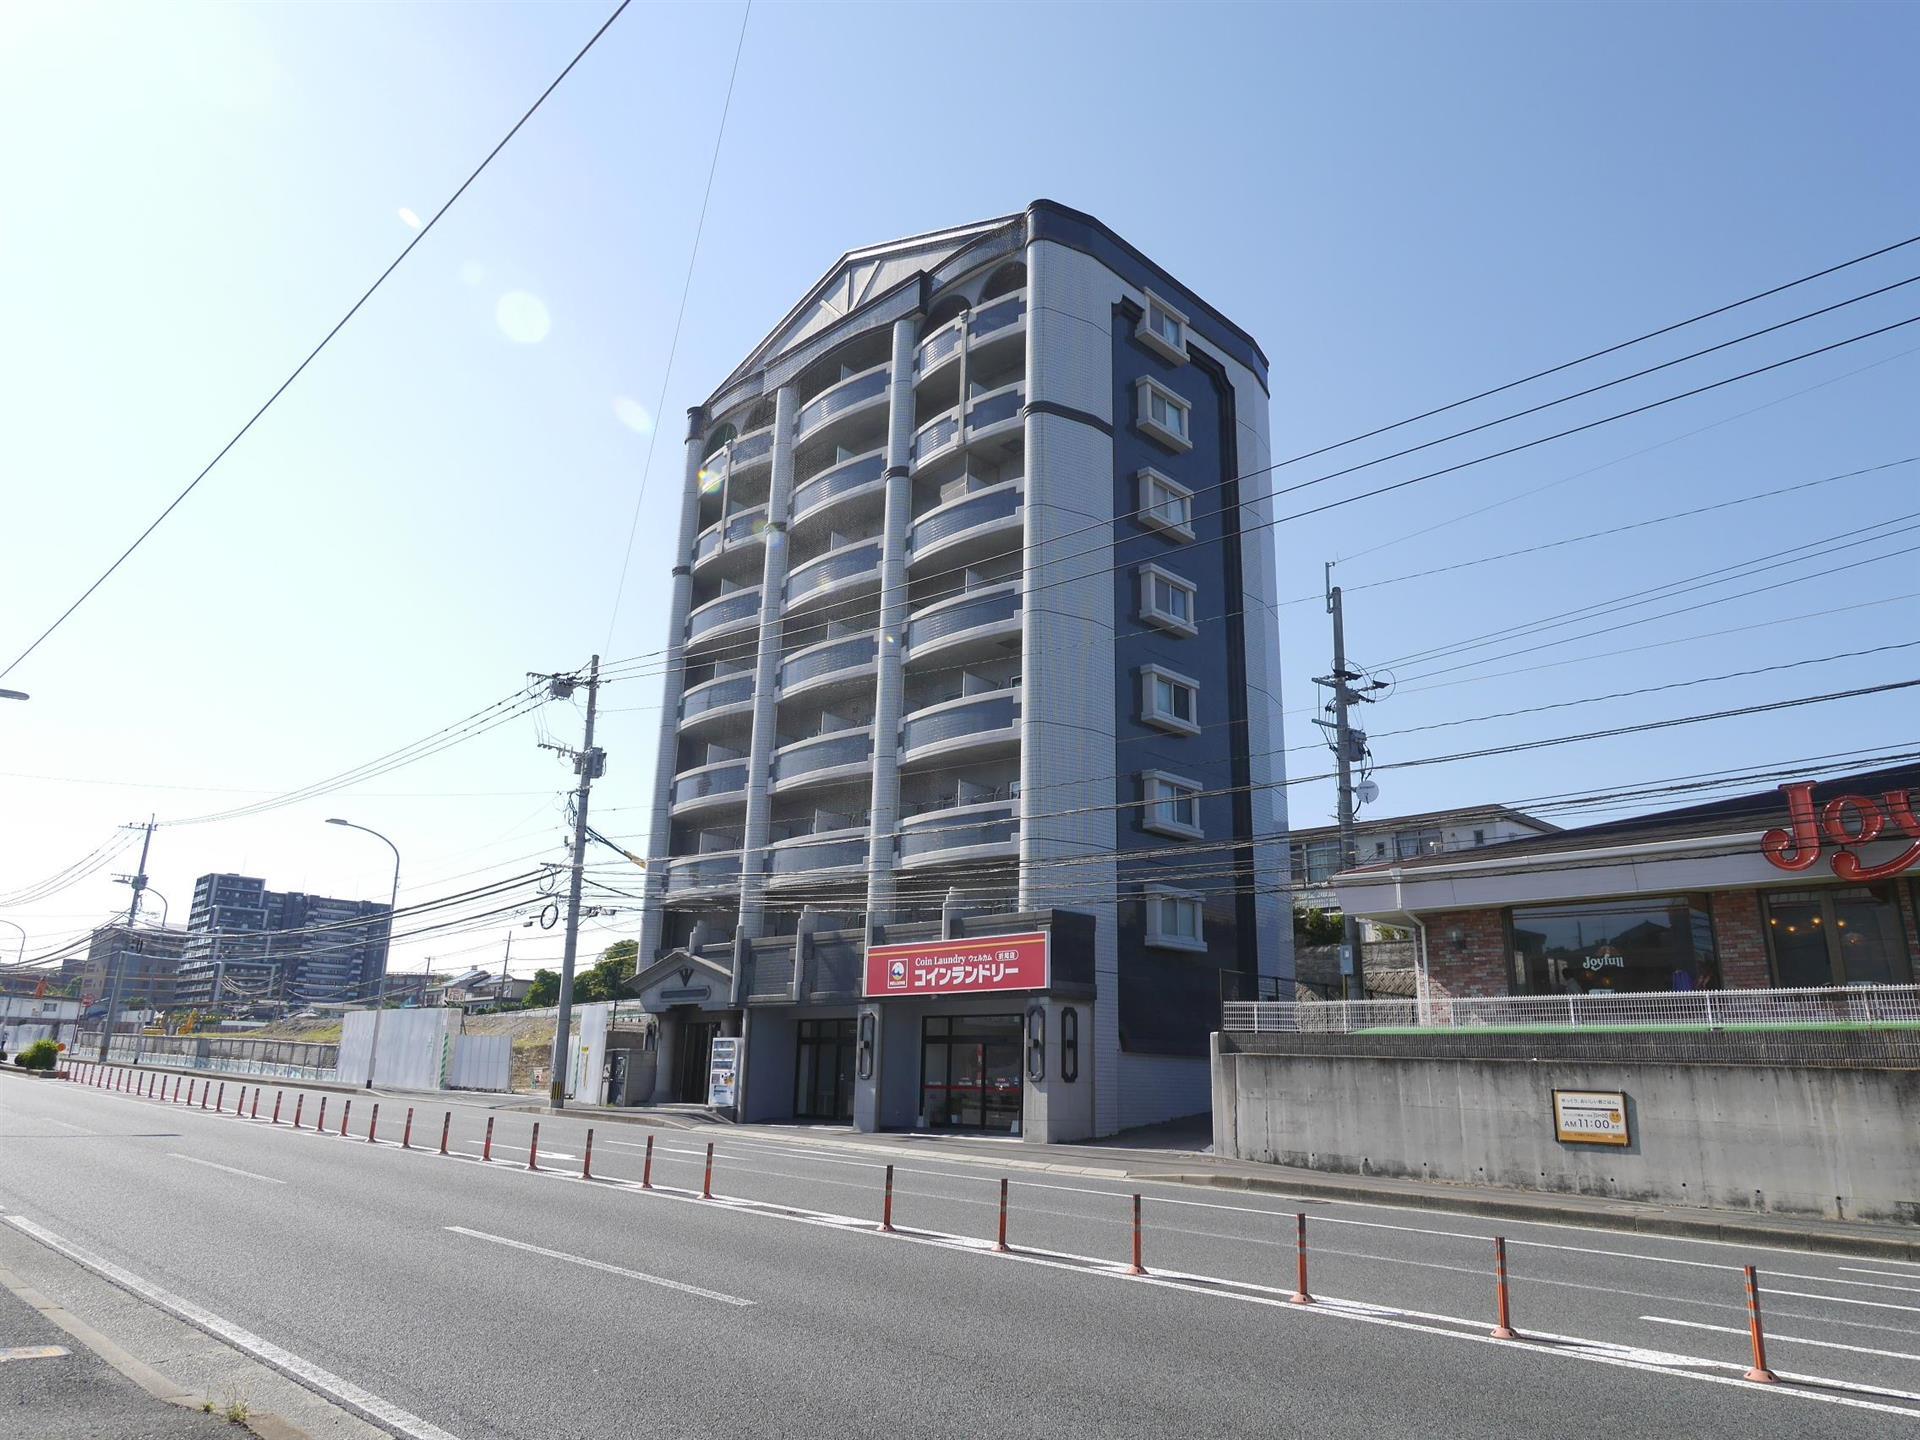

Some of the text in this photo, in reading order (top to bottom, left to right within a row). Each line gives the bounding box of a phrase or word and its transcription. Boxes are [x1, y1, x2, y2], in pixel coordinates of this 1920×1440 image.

[915, 957, 933, 967] Coin
[934, 954, 966, 966] Laundry
[1582, 953, 1625, 972] Joyfull
[914, 964, 1019, 986] コインランドリー
